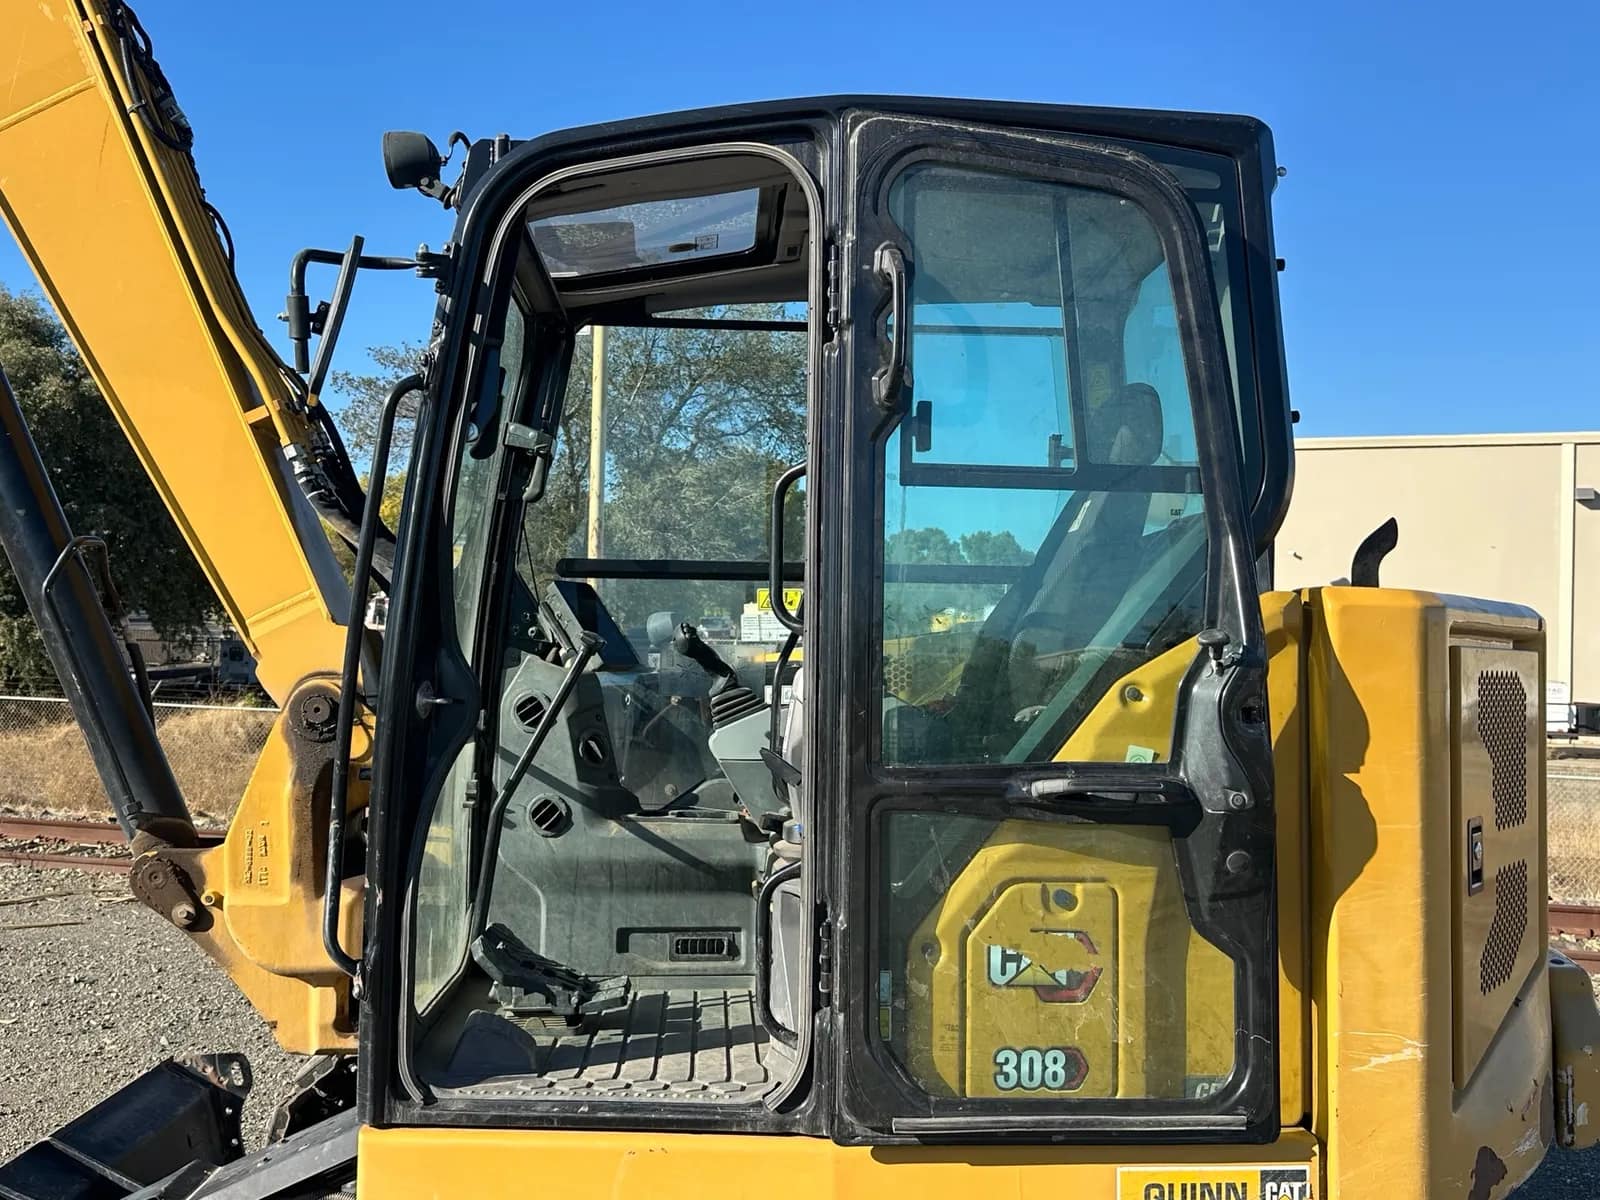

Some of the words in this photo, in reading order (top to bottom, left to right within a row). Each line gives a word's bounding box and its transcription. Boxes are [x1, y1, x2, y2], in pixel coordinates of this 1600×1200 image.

[995, 1048, 1066, 1089] 308
[1143, 1182, 1248, 1200] QUINN
[1265, 1181, 1303, 1200] CAT
